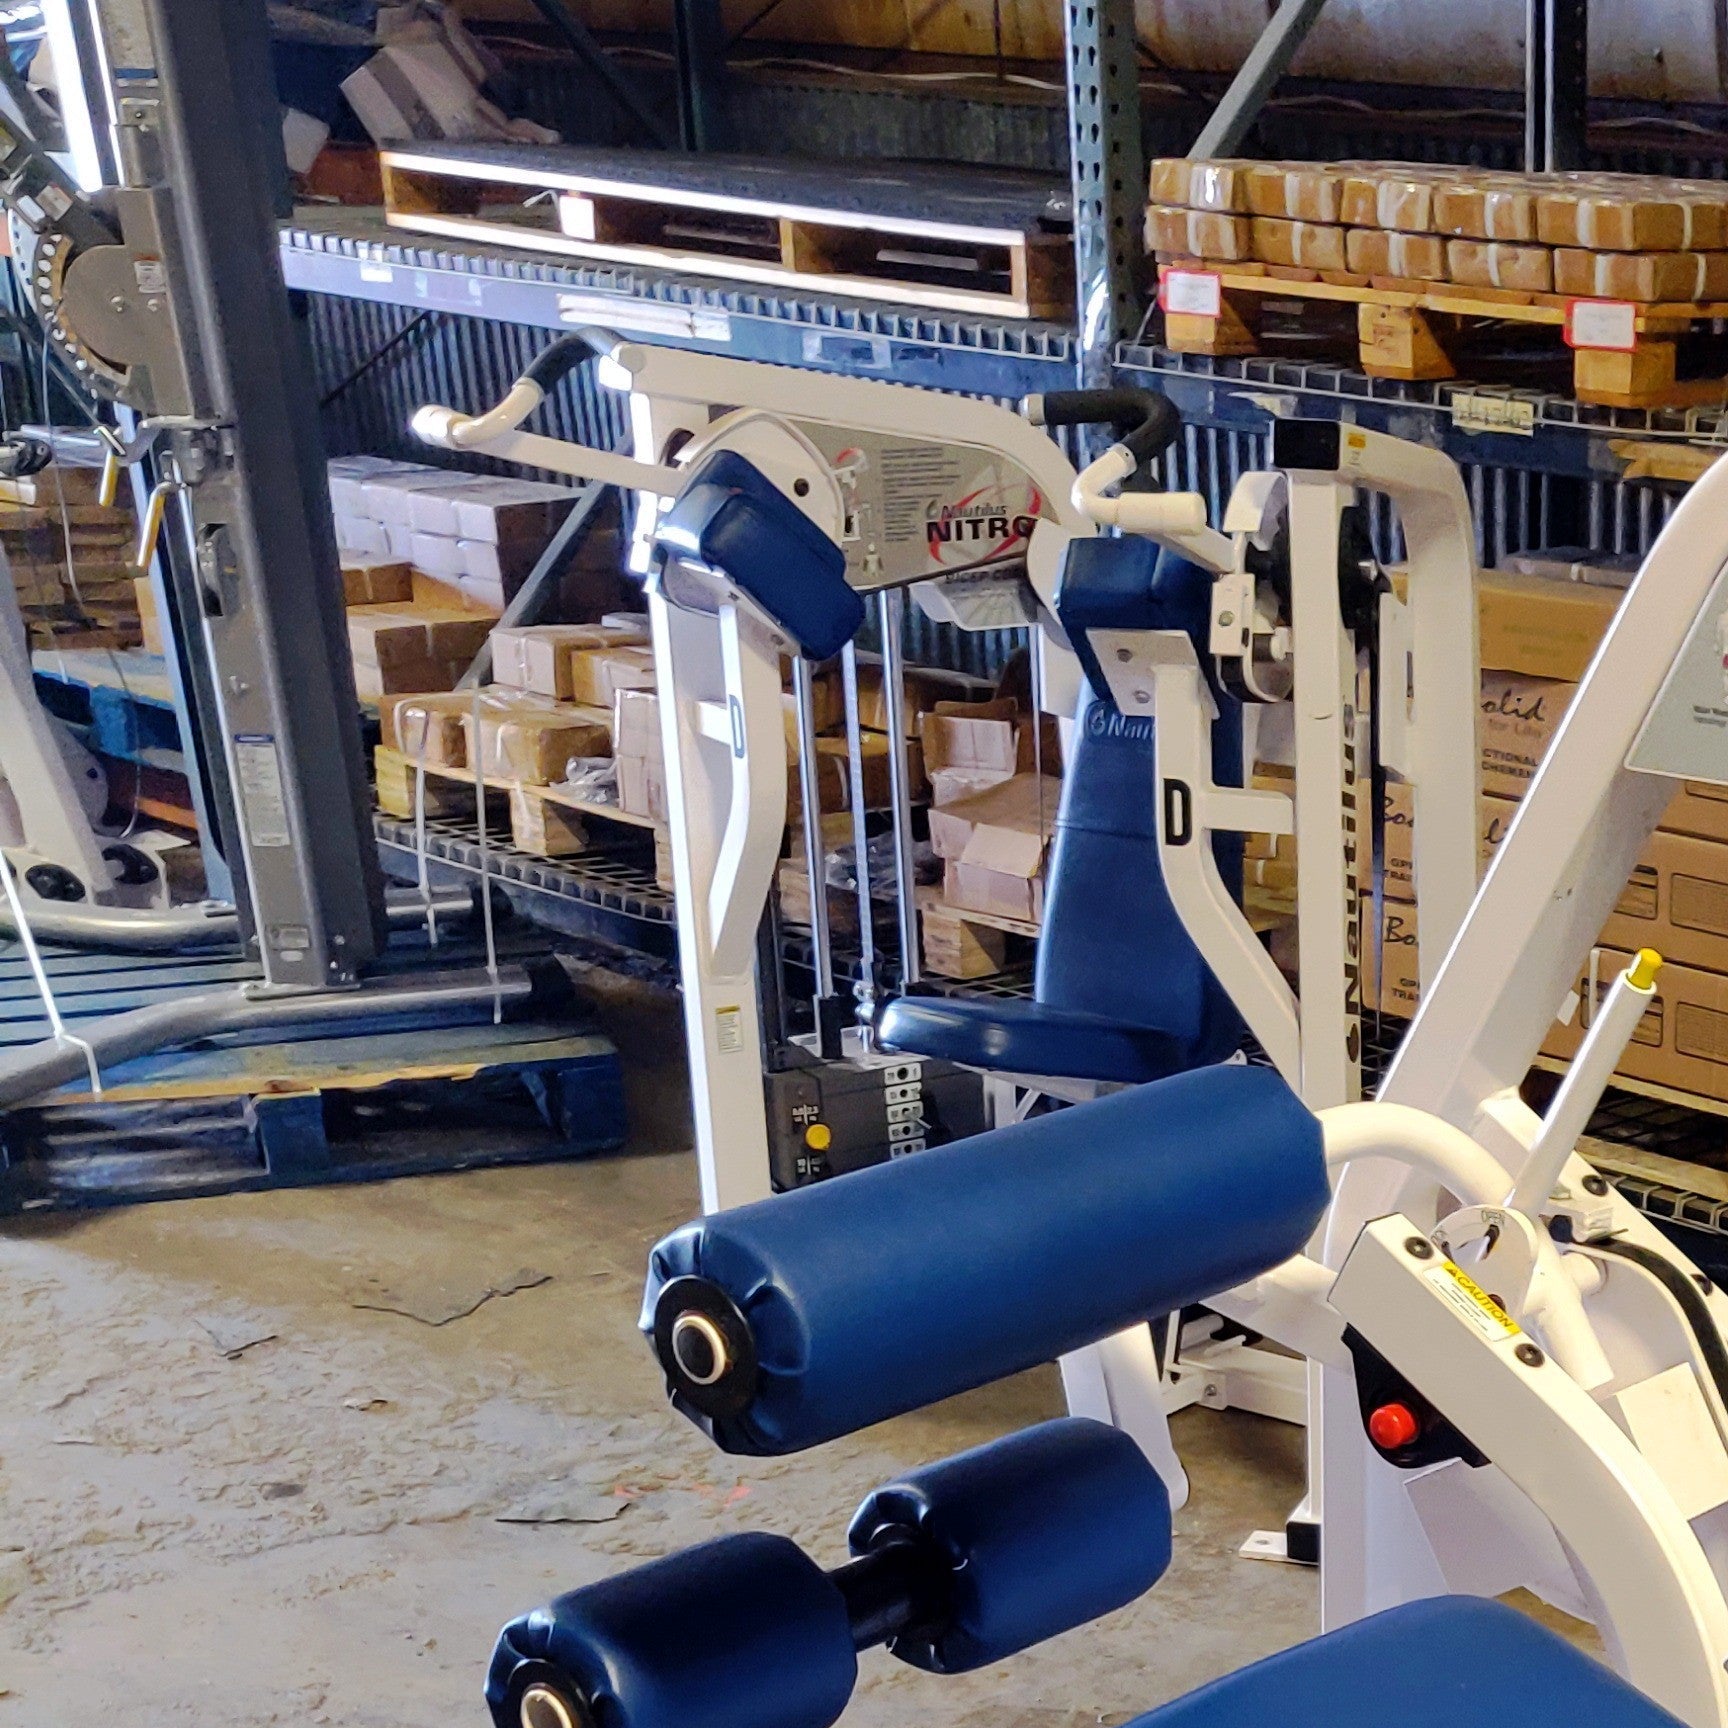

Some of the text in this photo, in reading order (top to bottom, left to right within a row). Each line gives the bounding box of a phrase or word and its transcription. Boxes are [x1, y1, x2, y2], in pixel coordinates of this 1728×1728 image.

[927, 515, 1039, 542] NITRO
[1163, 777, 1192, 847] D
[1342, 704, 1359, 1015] Nautilus
[1457, 1276, 1514, 1328] CAUTION
